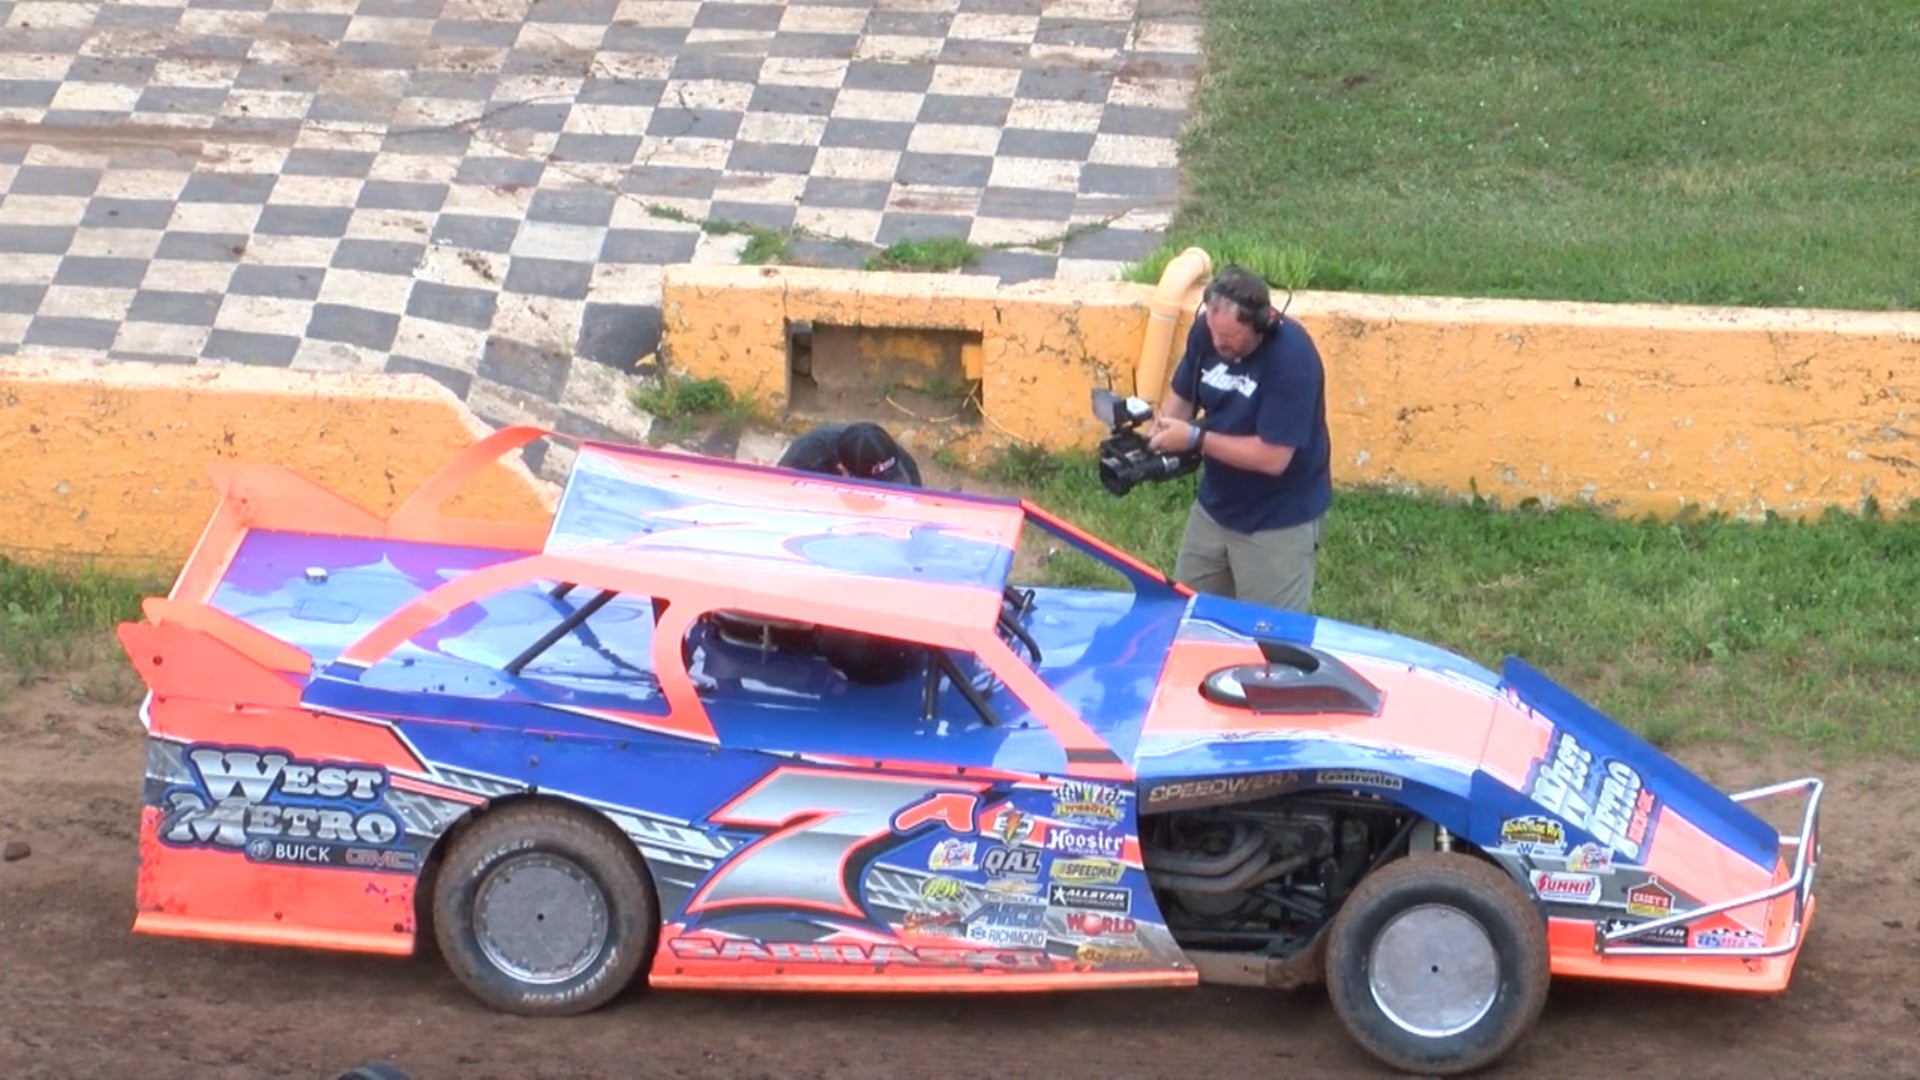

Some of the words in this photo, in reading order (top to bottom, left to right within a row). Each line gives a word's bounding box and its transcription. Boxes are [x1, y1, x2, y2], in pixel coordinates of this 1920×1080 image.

[1321, 771, 1401, 789] Construction
[684, 766, 988, 918] 7
[1046, 828, 1123, 850] Hoosier
[275, 843, 330, 863] BUICK
[984, 848, 1040, 876] QA1
[1065, 862, 1119, 878] SPEEDWAY
[1066, 887, 1126, 901] ALLSTAR
[1536, 873, 1596, 897] SUMMIT
[1066, 912, 1137, 936] WORLD
[988, 928, 1044, 945] RICHMOND
